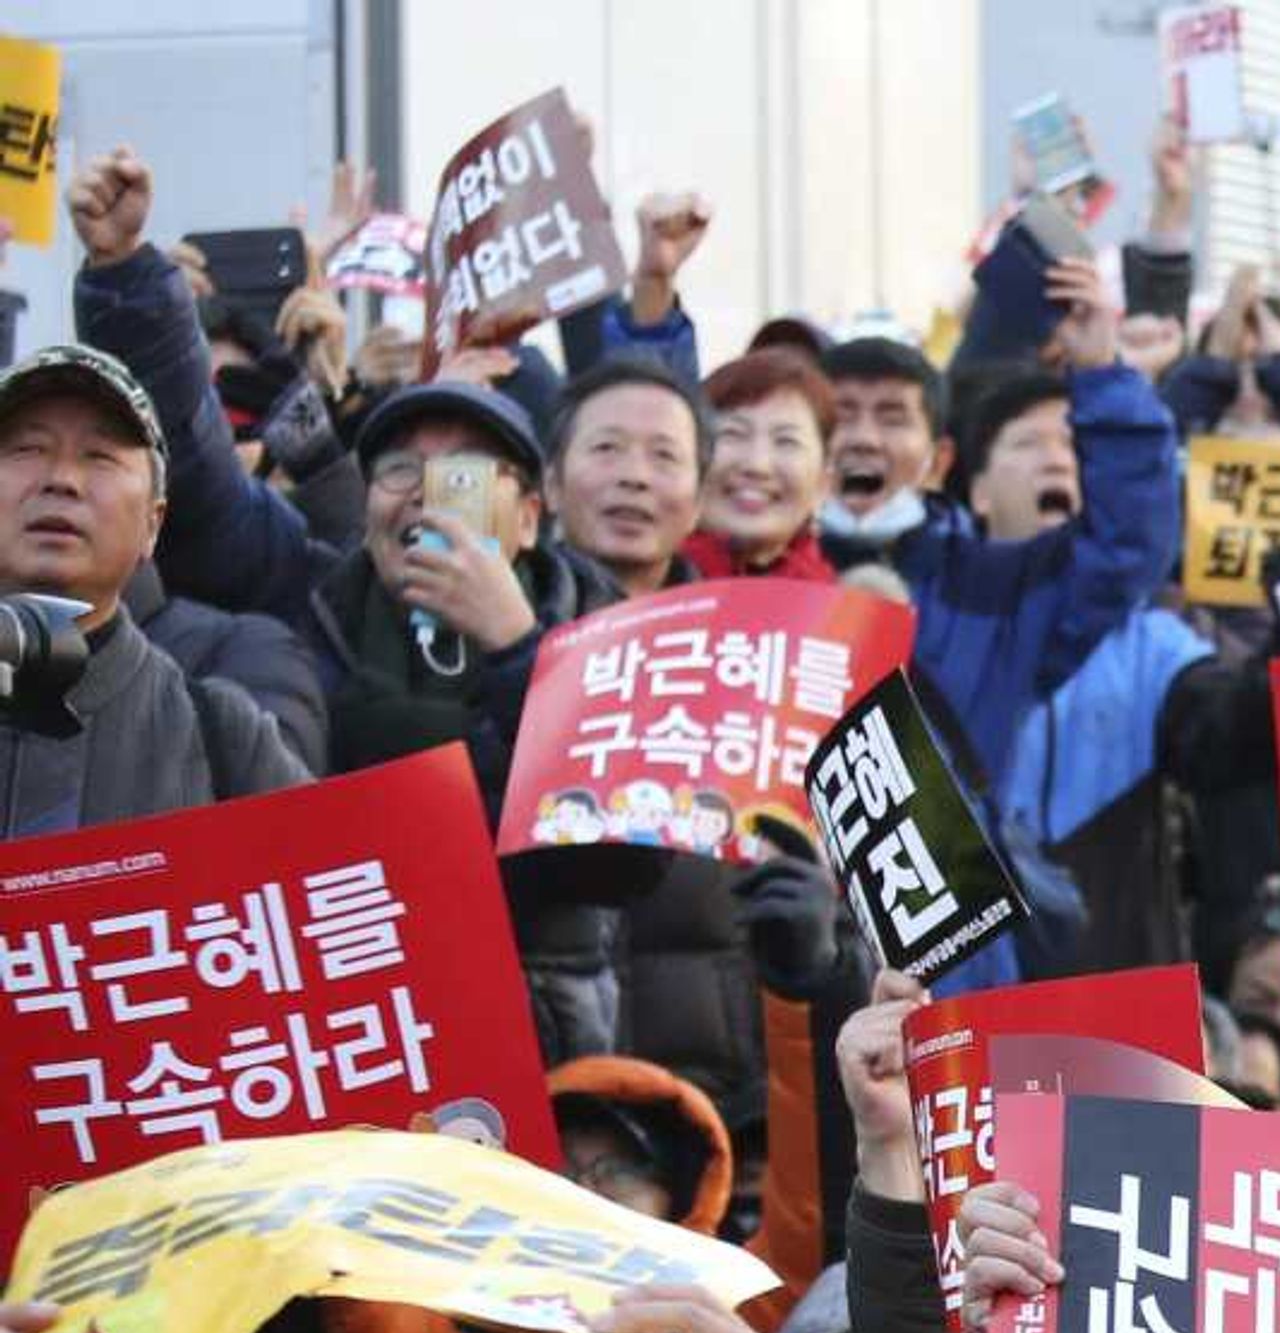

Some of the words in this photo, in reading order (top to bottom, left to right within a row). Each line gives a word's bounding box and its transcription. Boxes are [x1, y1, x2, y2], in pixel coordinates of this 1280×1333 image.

[582, 628, 853, 719] 박근혜를
[0, 860, 406, 1032] 박근혜를
[848, 816, 960, 968] 진
[31, 986, 435, 1164] 구속하라
